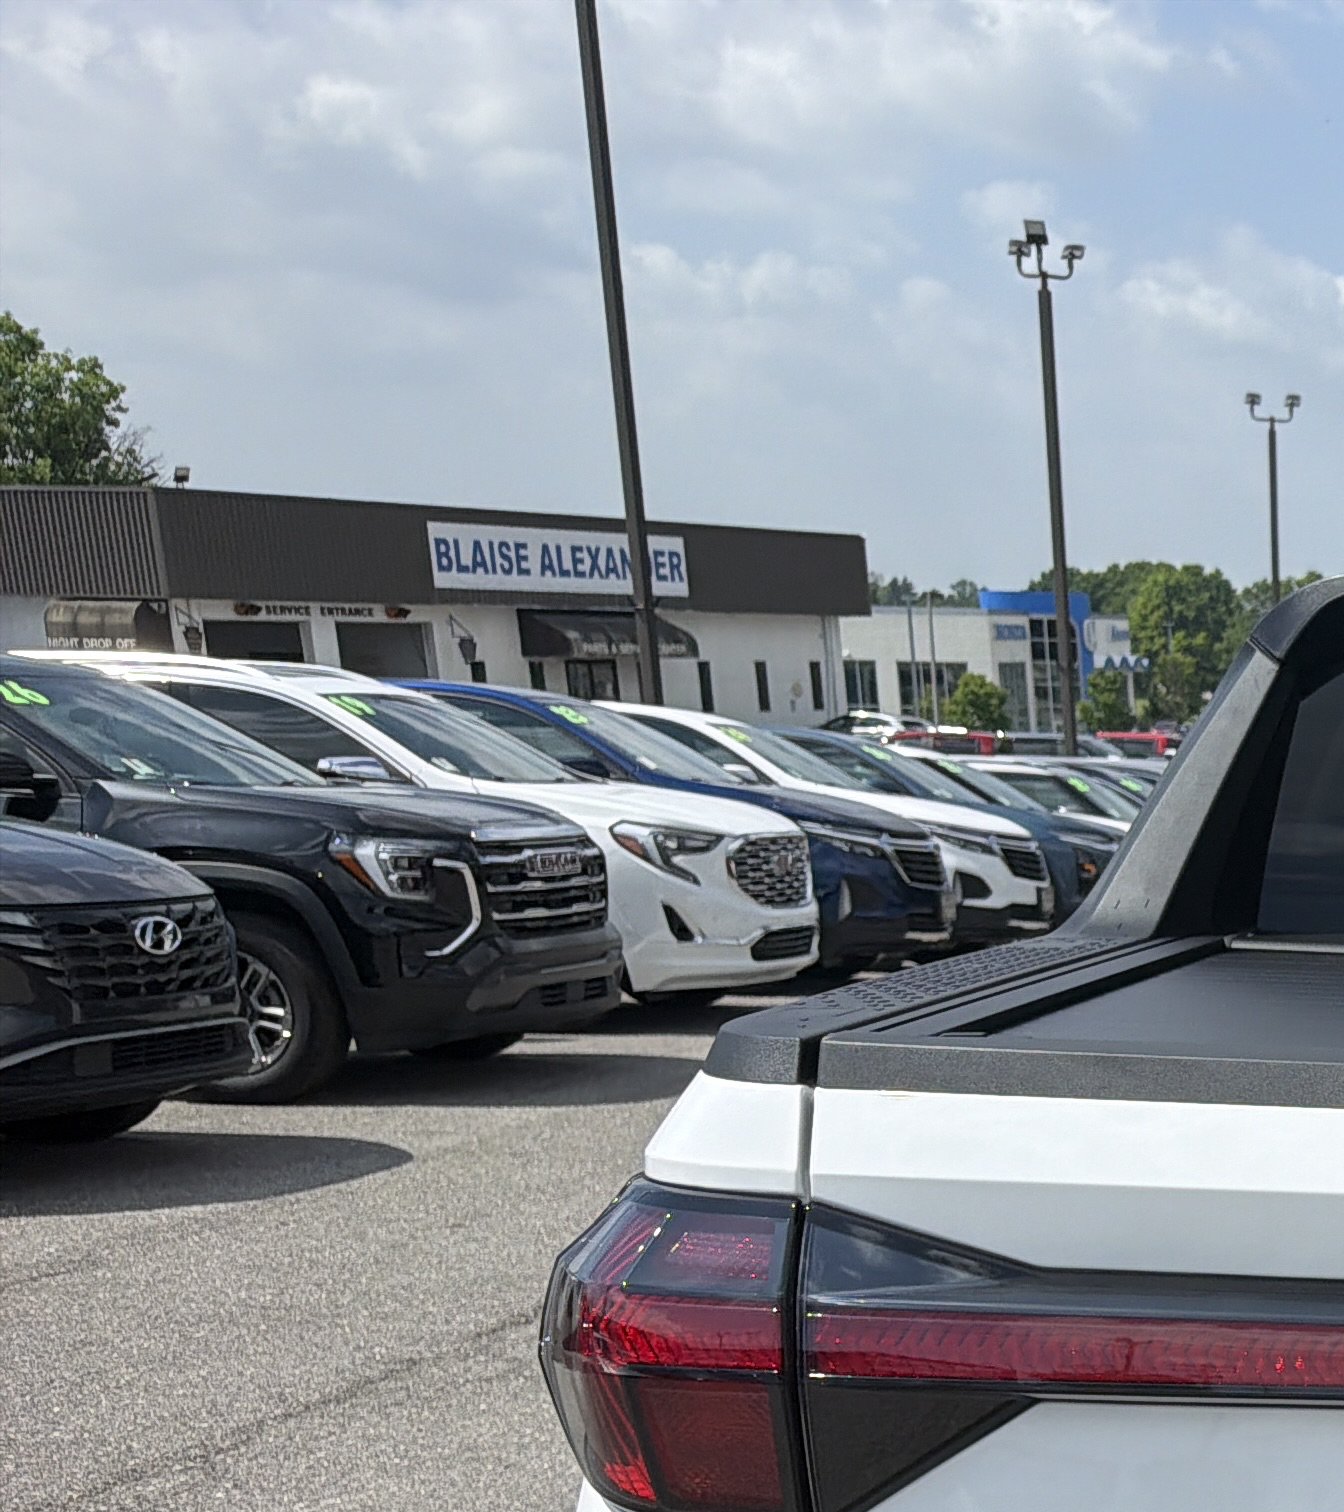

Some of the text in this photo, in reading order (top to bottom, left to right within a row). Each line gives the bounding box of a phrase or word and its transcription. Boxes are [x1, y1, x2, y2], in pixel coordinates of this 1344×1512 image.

[434, 537, 685, 583] BLAISE ALEXANER
[264, 604, 374, 618] SERVICE ENTRANCE
[48, 636, 138, 649] NIGHT DROP OFF
